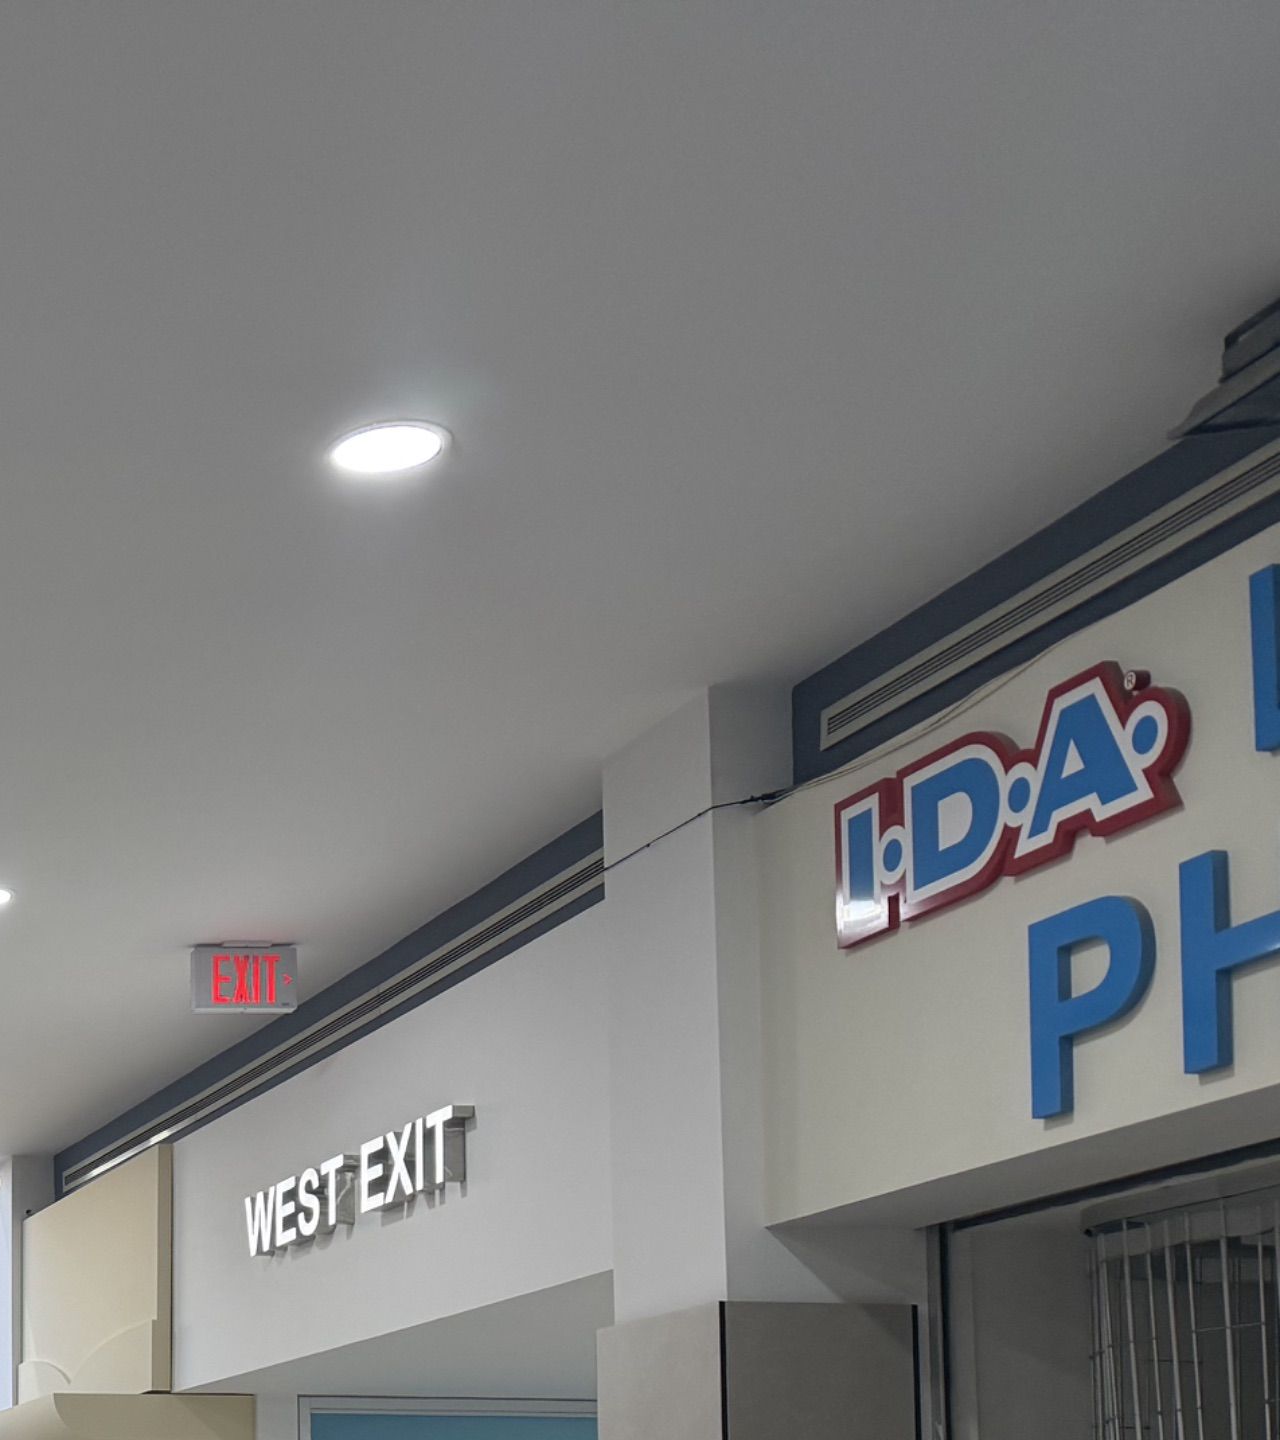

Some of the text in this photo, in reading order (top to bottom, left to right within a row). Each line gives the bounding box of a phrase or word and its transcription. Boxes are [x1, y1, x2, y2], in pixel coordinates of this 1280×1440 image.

[212, 954, 281, 1005] EXIT
[244, 1104, 457, 1257] WEST EXIT
